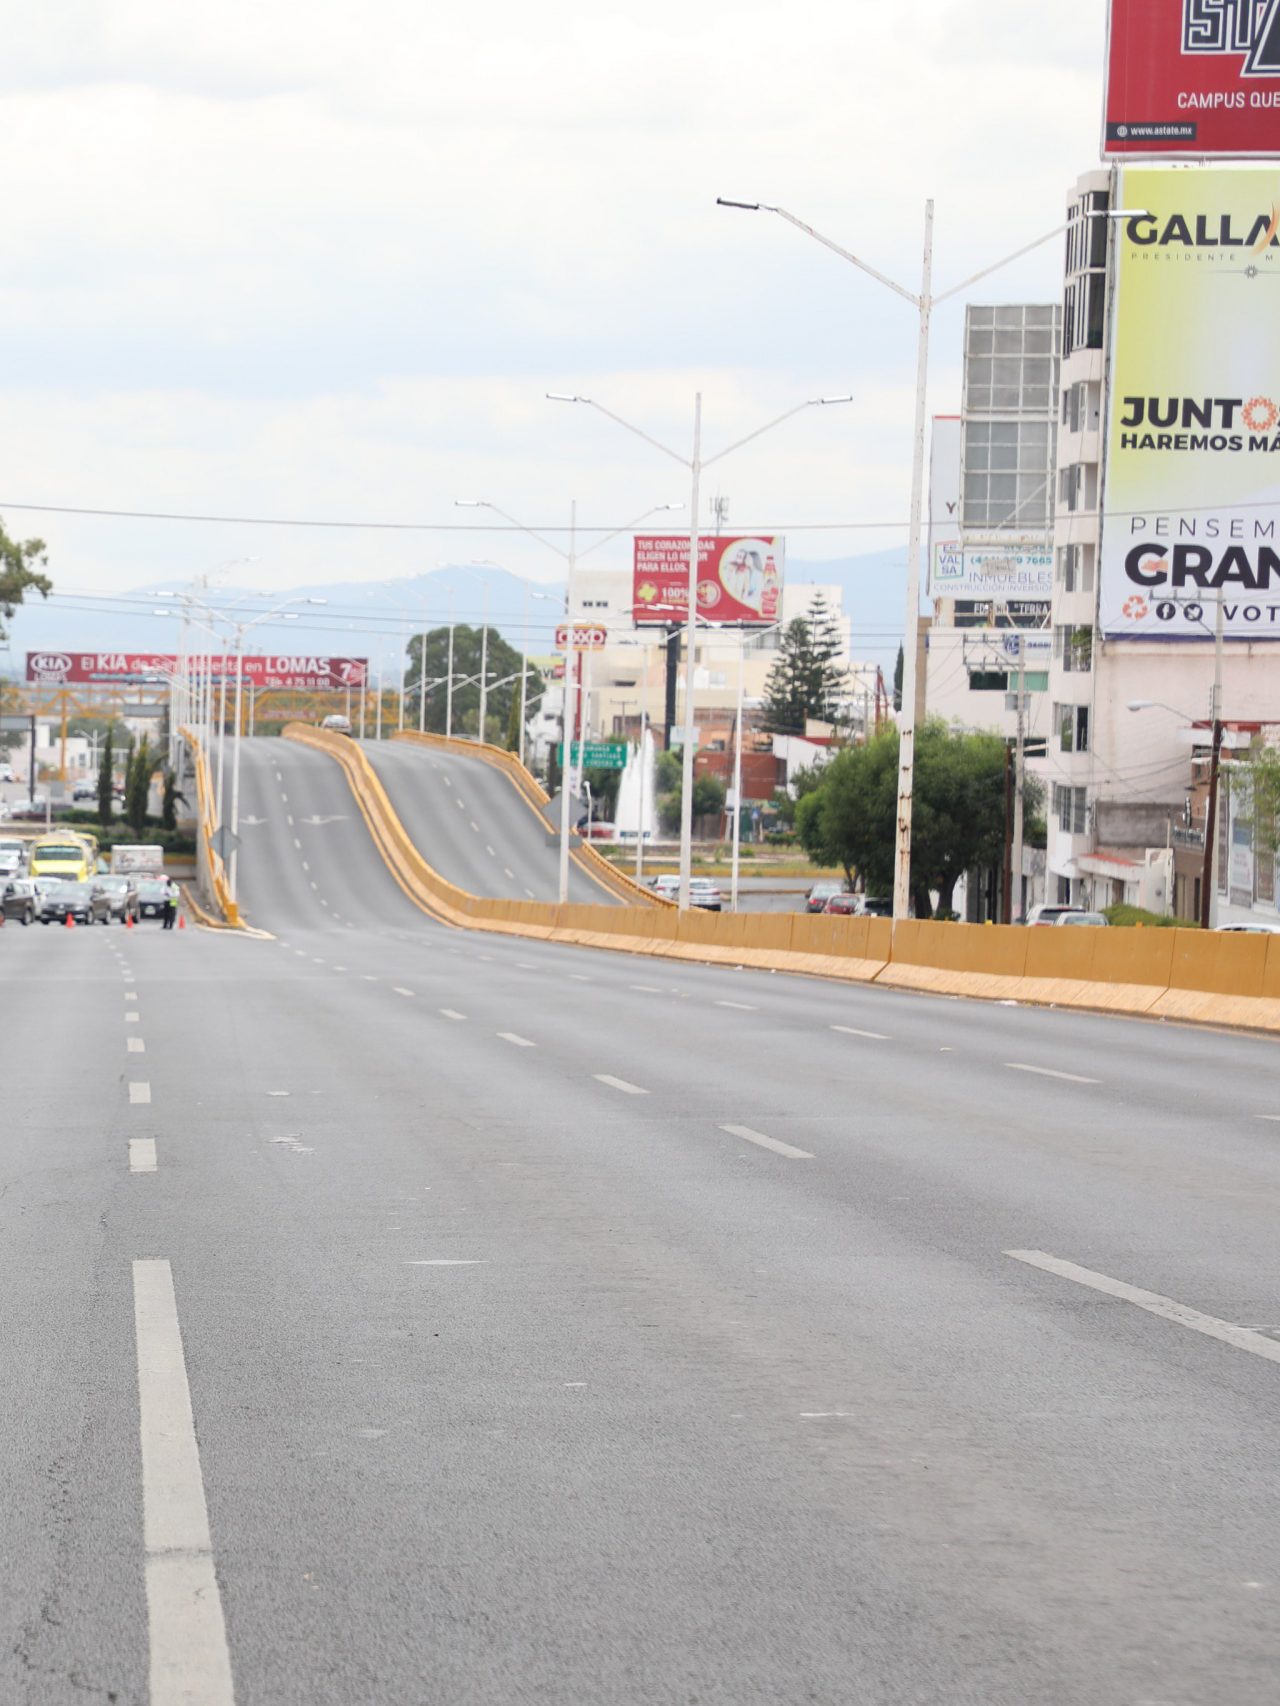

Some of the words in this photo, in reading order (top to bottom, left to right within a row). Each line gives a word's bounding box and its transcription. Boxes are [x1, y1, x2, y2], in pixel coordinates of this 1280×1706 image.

[1177, 92, 1245, 109] CAMPUS
[1130, 126, 1192, 136] www.astate.mx
[1131, 253, 1235, 261] PRESIDENTE
[1120, 396, 1280, 432] JUNTO
[1120, 433, 1243, 451] HAREMOS
[37, 656, 66, 670] KIA
[97, 653, 129, 672] KIA
[265, 656, 331, 675] LOMAS
